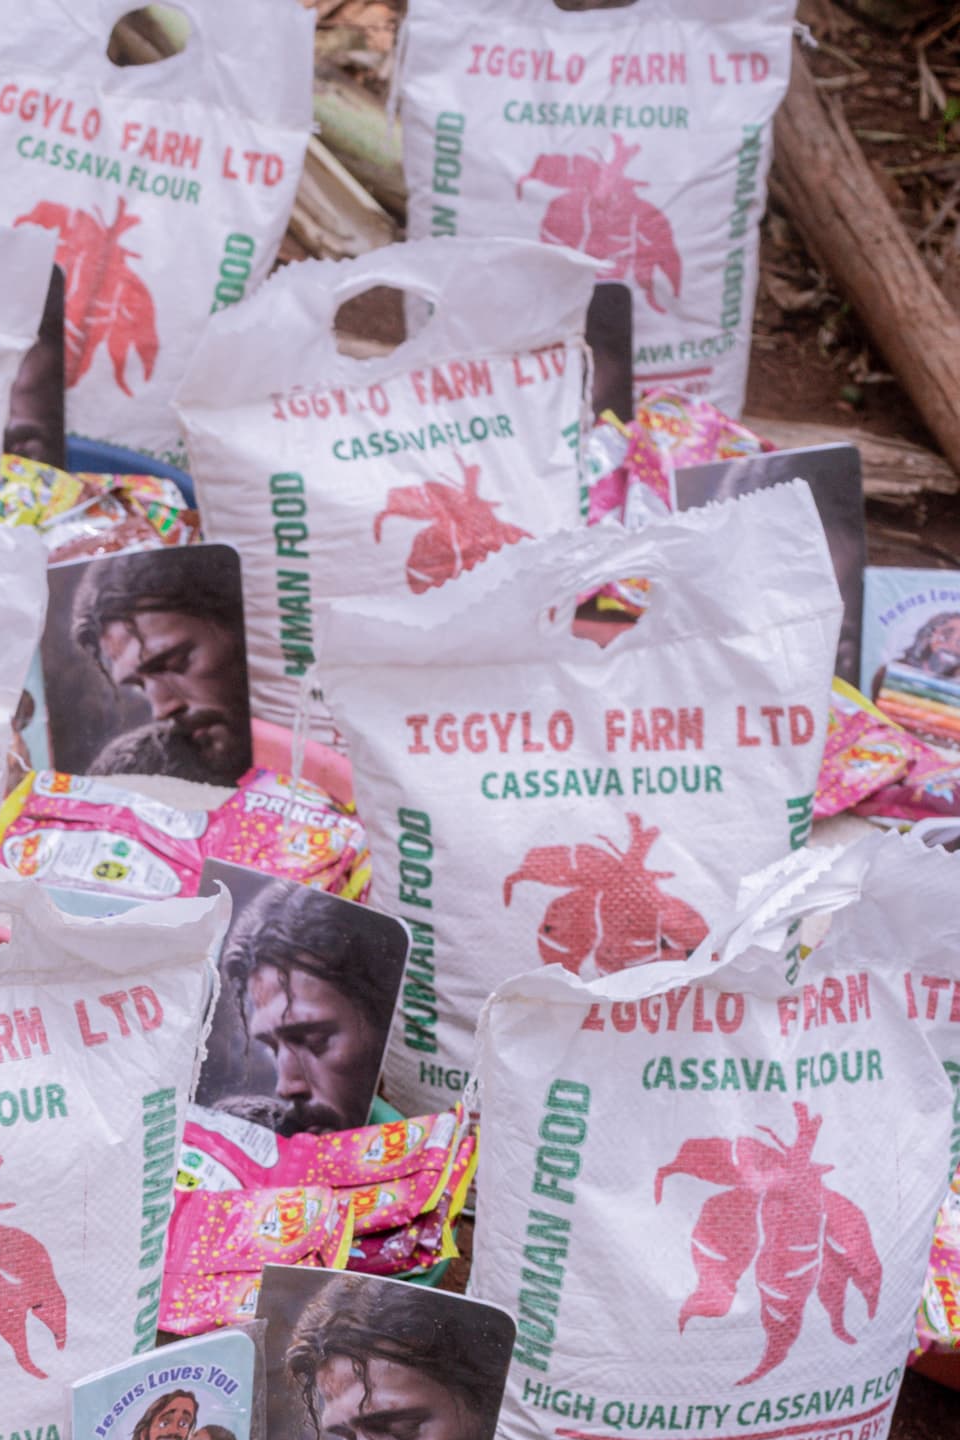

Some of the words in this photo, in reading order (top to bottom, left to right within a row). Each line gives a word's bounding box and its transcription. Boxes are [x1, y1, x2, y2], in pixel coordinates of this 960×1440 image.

[467, 44, 585, 85] IGGYLO
[610, 53, 685, 84] FARM
[709, 52, 769, 84] LTD
[503, 100, 606, 126] CASSAVA
[611, 105, 688, 128] FLOUR
[17, 136, 122, 183] CASSAVA
[128, 169, 199, 204] FLOUR
[121, 123, 201, 169] FARM
[222, 147, 284, 186] LTD
[411, 362, 492, 403] FARM
[270, 472, 309, 558] FOOD
[277, 569, 313, 677] HUMAN
[406, 710, 574, 754] IGGYLO
[606, 708, 703, 752] FARM
[737, 705, 814, 746] LTD
[482, 768, 623, 800] CASSAVA
[633, 765, 722, 794] FLOUR
[398, 810, 433, 908] FOOD
[75, 986, 163, 1046] LTD
[402, 921, 437, 1053] HUMAN
[778, 973, 871, 1036] FARM
[643, 1056, 788, 1092] CASSAVA
[796, 1049, 883, 1089] FLOUR
[532, 1079, 591, 1204] FOOD
[512, 1210, 571, 1371] HUMAN
[93, 1378, 145, 1439] Jesus
[148, 1364, 204, 1390] Loves
[206, 1365, 240, 1396] You
[602, 1400, 731, 1432] QUALITY
[736, 1385, 854, 1428] CASSAVA
